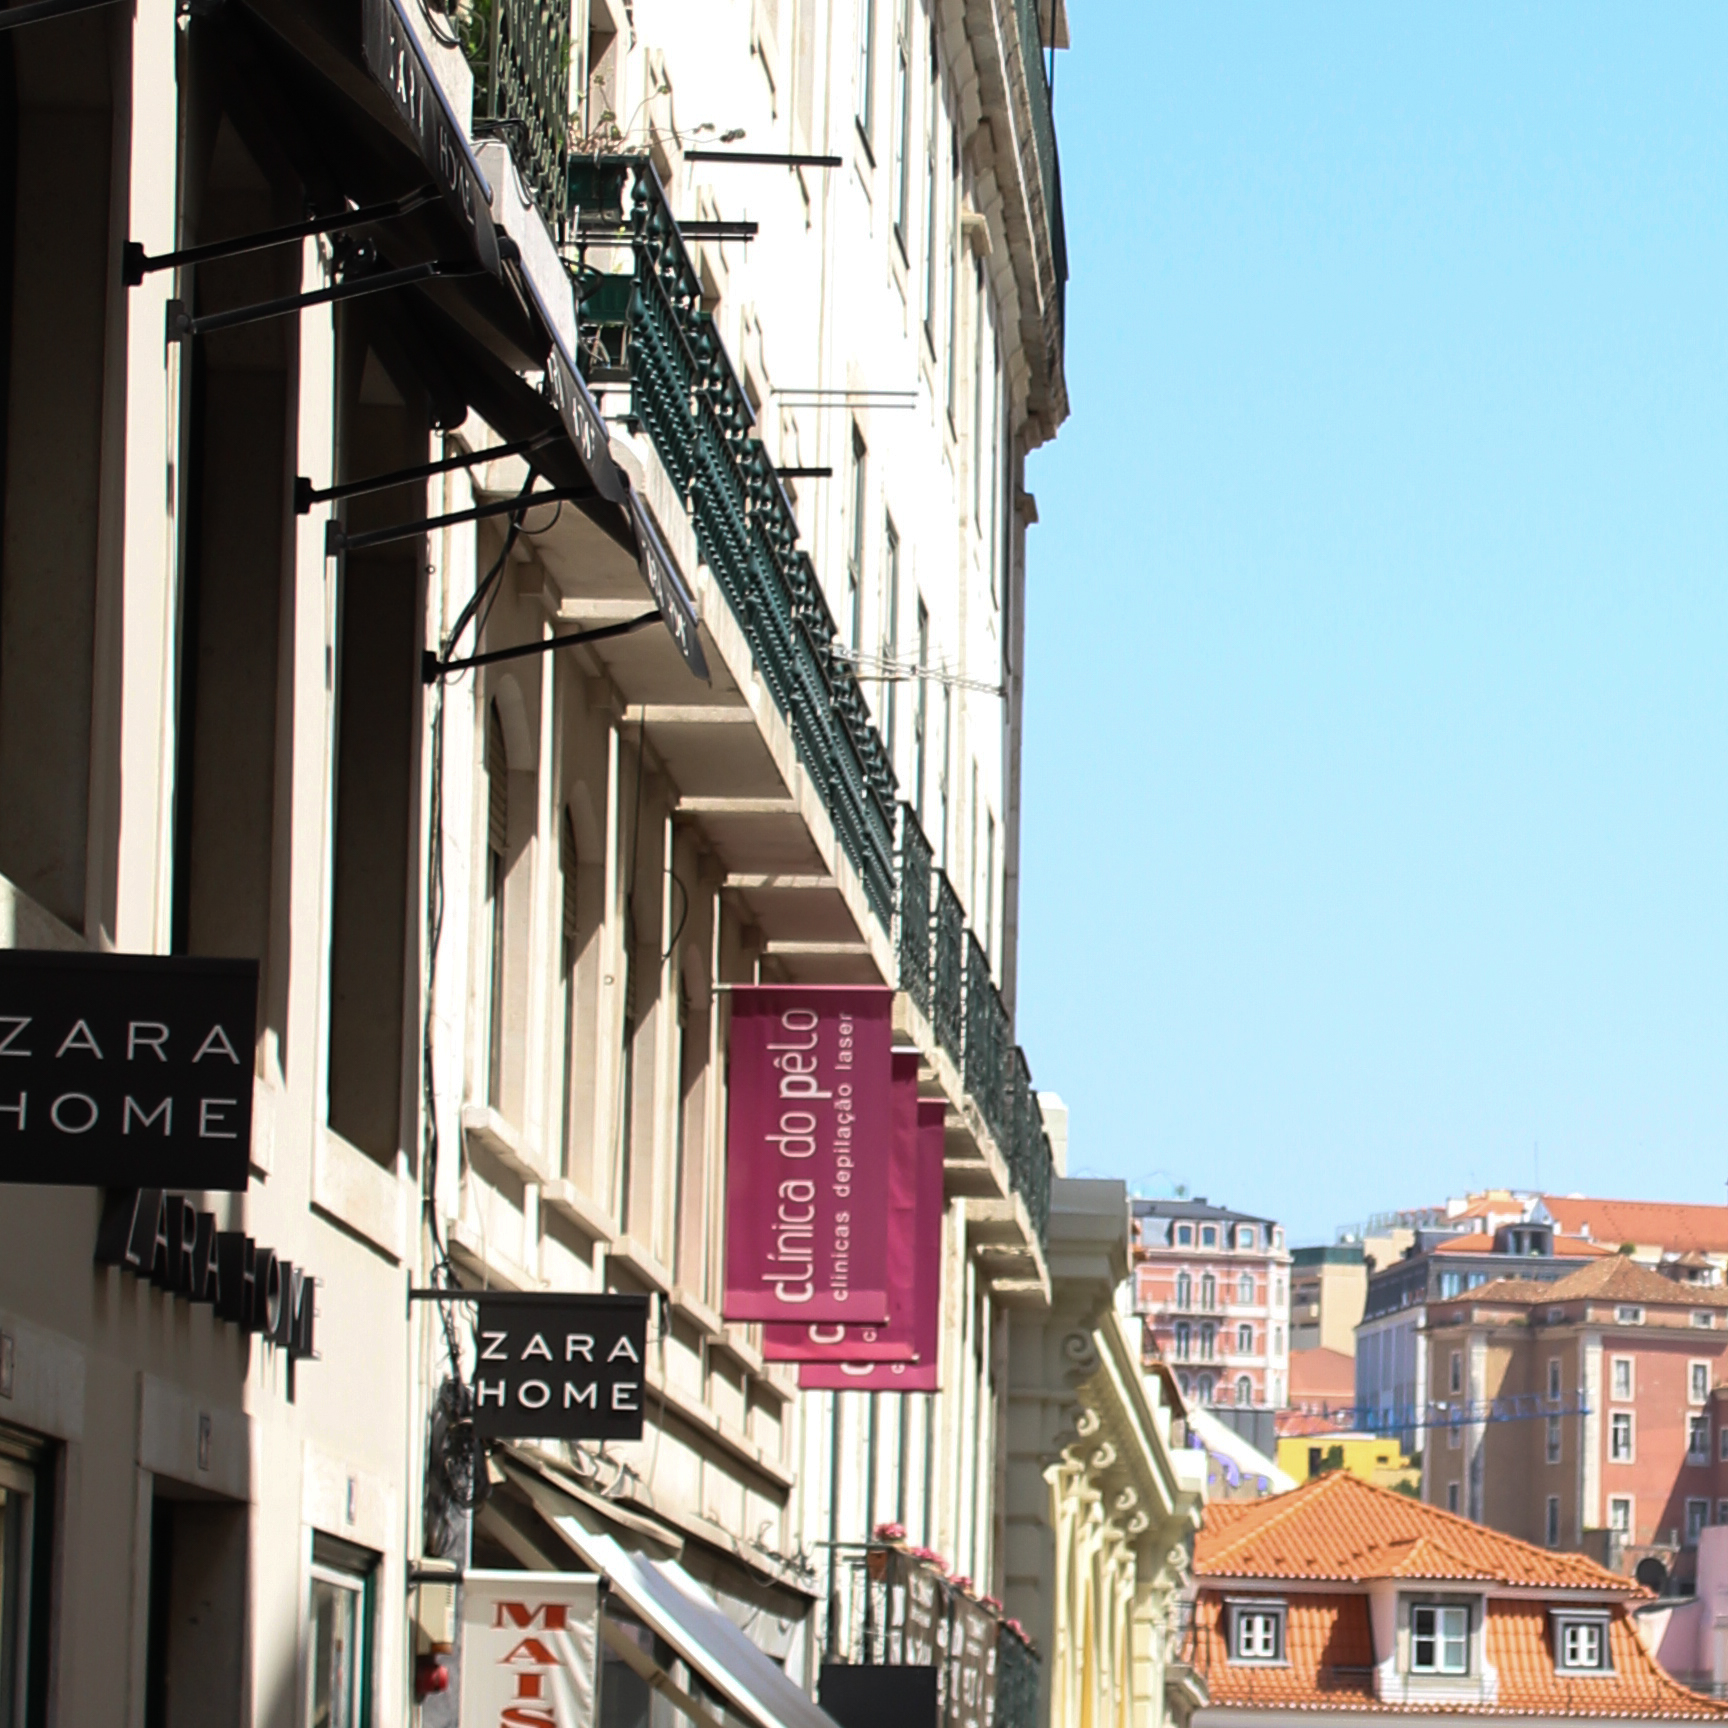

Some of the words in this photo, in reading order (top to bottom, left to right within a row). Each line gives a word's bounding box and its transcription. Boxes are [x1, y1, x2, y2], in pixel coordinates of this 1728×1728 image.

[0, 1017, 241, 1065] ZARA
[766, 1007, 833, 1100] pêlo
[835, 1012, 854, 1071] laser
[0, 1091, 238, 1139] HOME
[765, 1110, 817, 1159] do
[833, 1083, 855, 1198] depilação
[761, 1179, 815, 1304] clínica
[481, 1331, 640, 1364] ZARA
[477, 1379, 639, 1411] HOME
